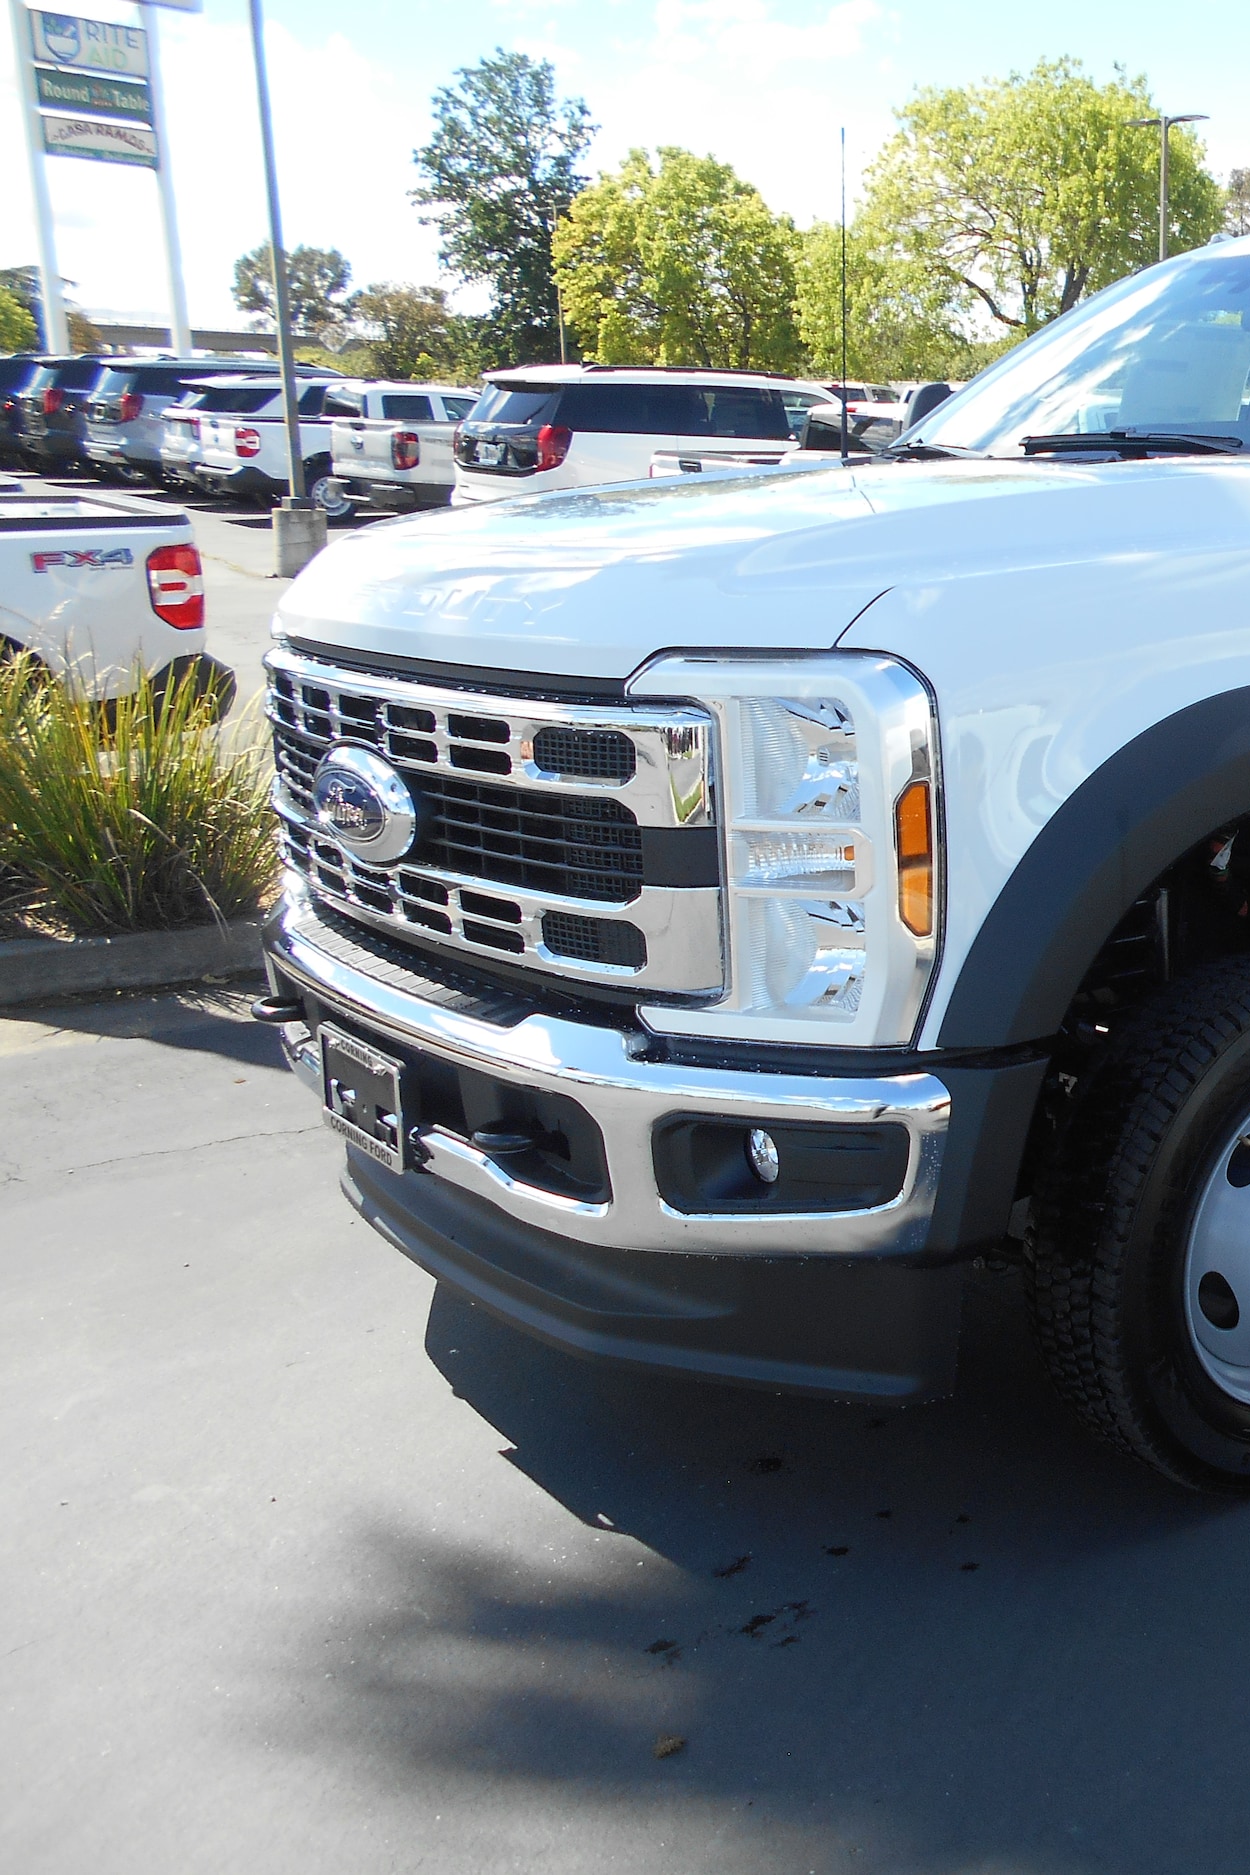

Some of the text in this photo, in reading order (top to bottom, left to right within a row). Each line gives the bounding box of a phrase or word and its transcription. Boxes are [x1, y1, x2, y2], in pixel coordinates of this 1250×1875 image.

[84, 22, 139, 49] RITE
[90, 48, 128, 68] AID
[42, 79, 149, 111] Round Table
[59, 124, 145, 151] CASA RAMOS
[31, 548, 134, 573] FX4
[341, 1039, 374, 1068] CORNING
[330, 1116, 393, 1166] CORNING FORD
